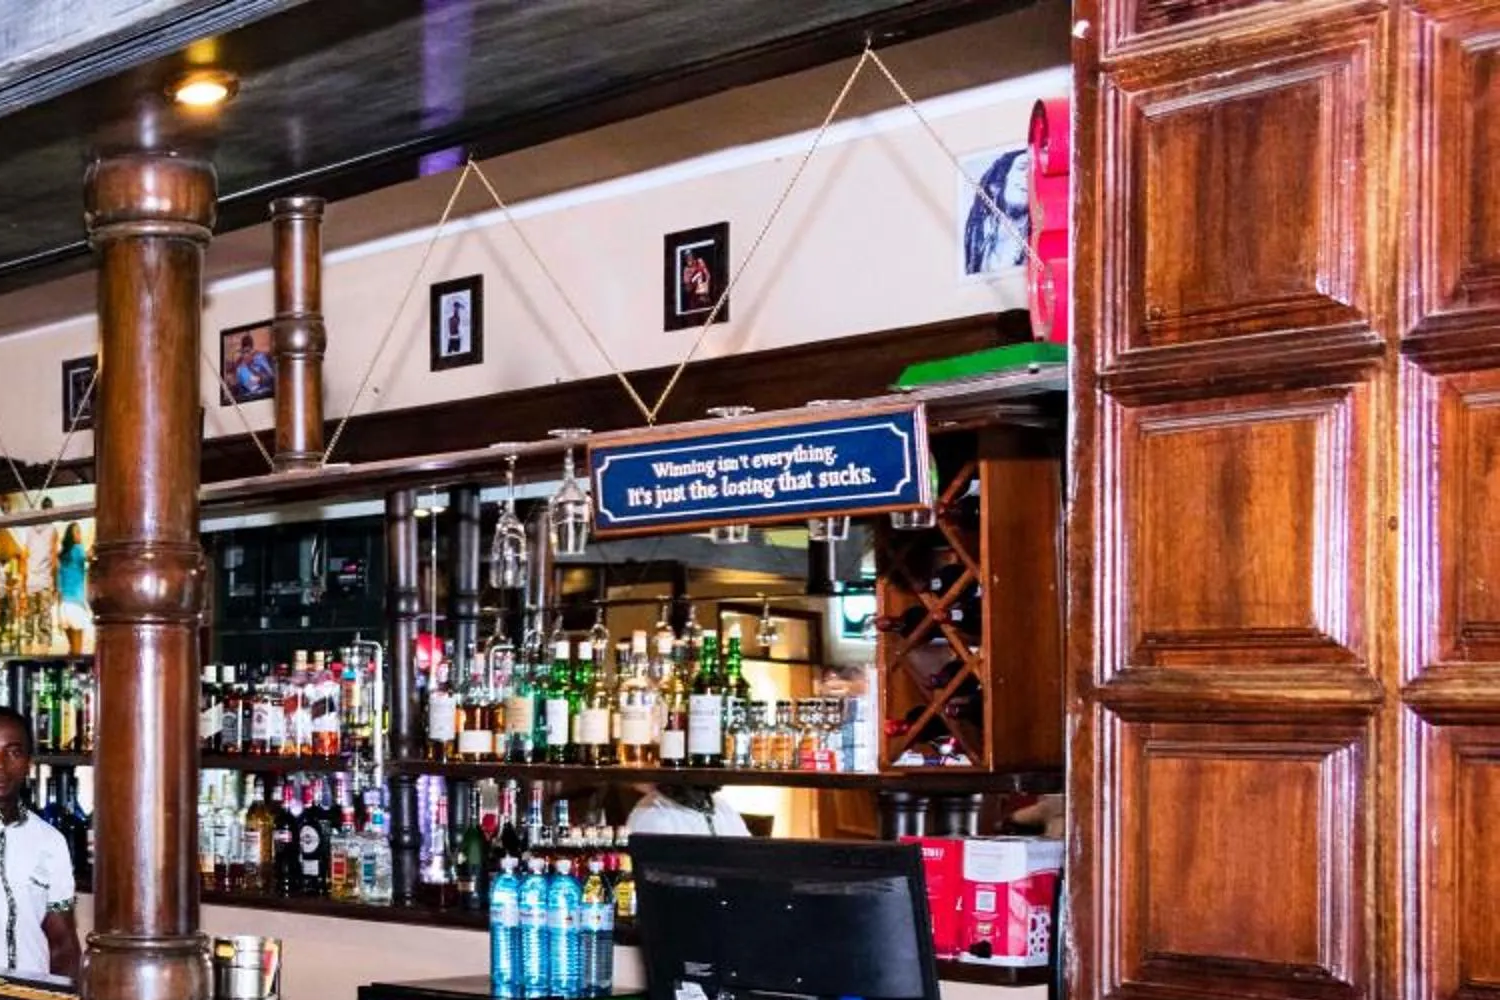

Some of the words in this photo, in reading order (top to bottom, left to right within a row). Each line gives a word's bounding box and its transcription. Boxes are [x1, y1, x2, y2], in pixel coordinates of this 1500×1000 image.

[652, 460, 716, 478] Winning
[718, 455, 750, 471] isn't
[752, 444, 838, 470] everything.
[627, 486, 652, 507] It's
[655, 484, 687, 508] just
[689, 480, 719, 500] the
[721, 475, 775, 498] losing
[778, 470, 814, 491] that
[818, 462, 876, 488] sucks.
